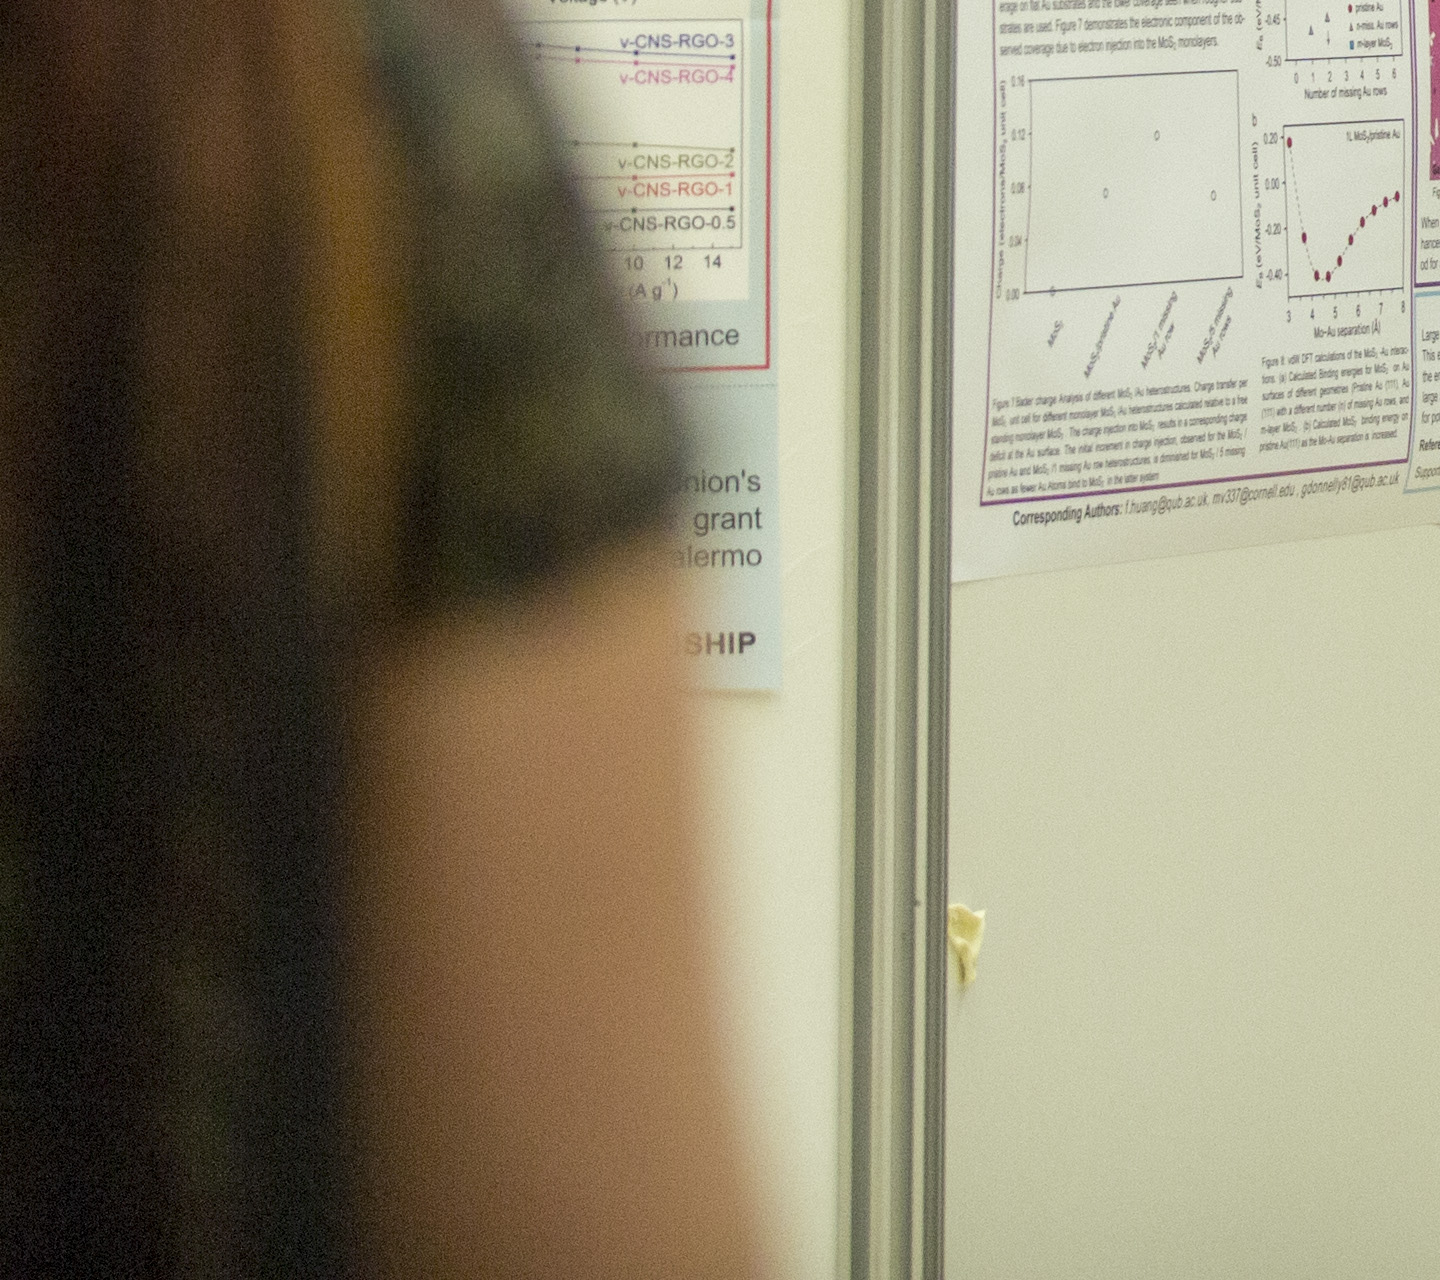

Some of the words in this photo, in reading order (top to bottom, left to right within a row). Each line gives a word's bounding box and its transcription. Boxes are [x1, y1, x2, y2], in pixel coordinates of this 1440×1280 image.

[692, 506, 763, 537] grant
[1012, 505, 1081, 527] Corresponding
[1084, 500, 1123, 520] Authors:
